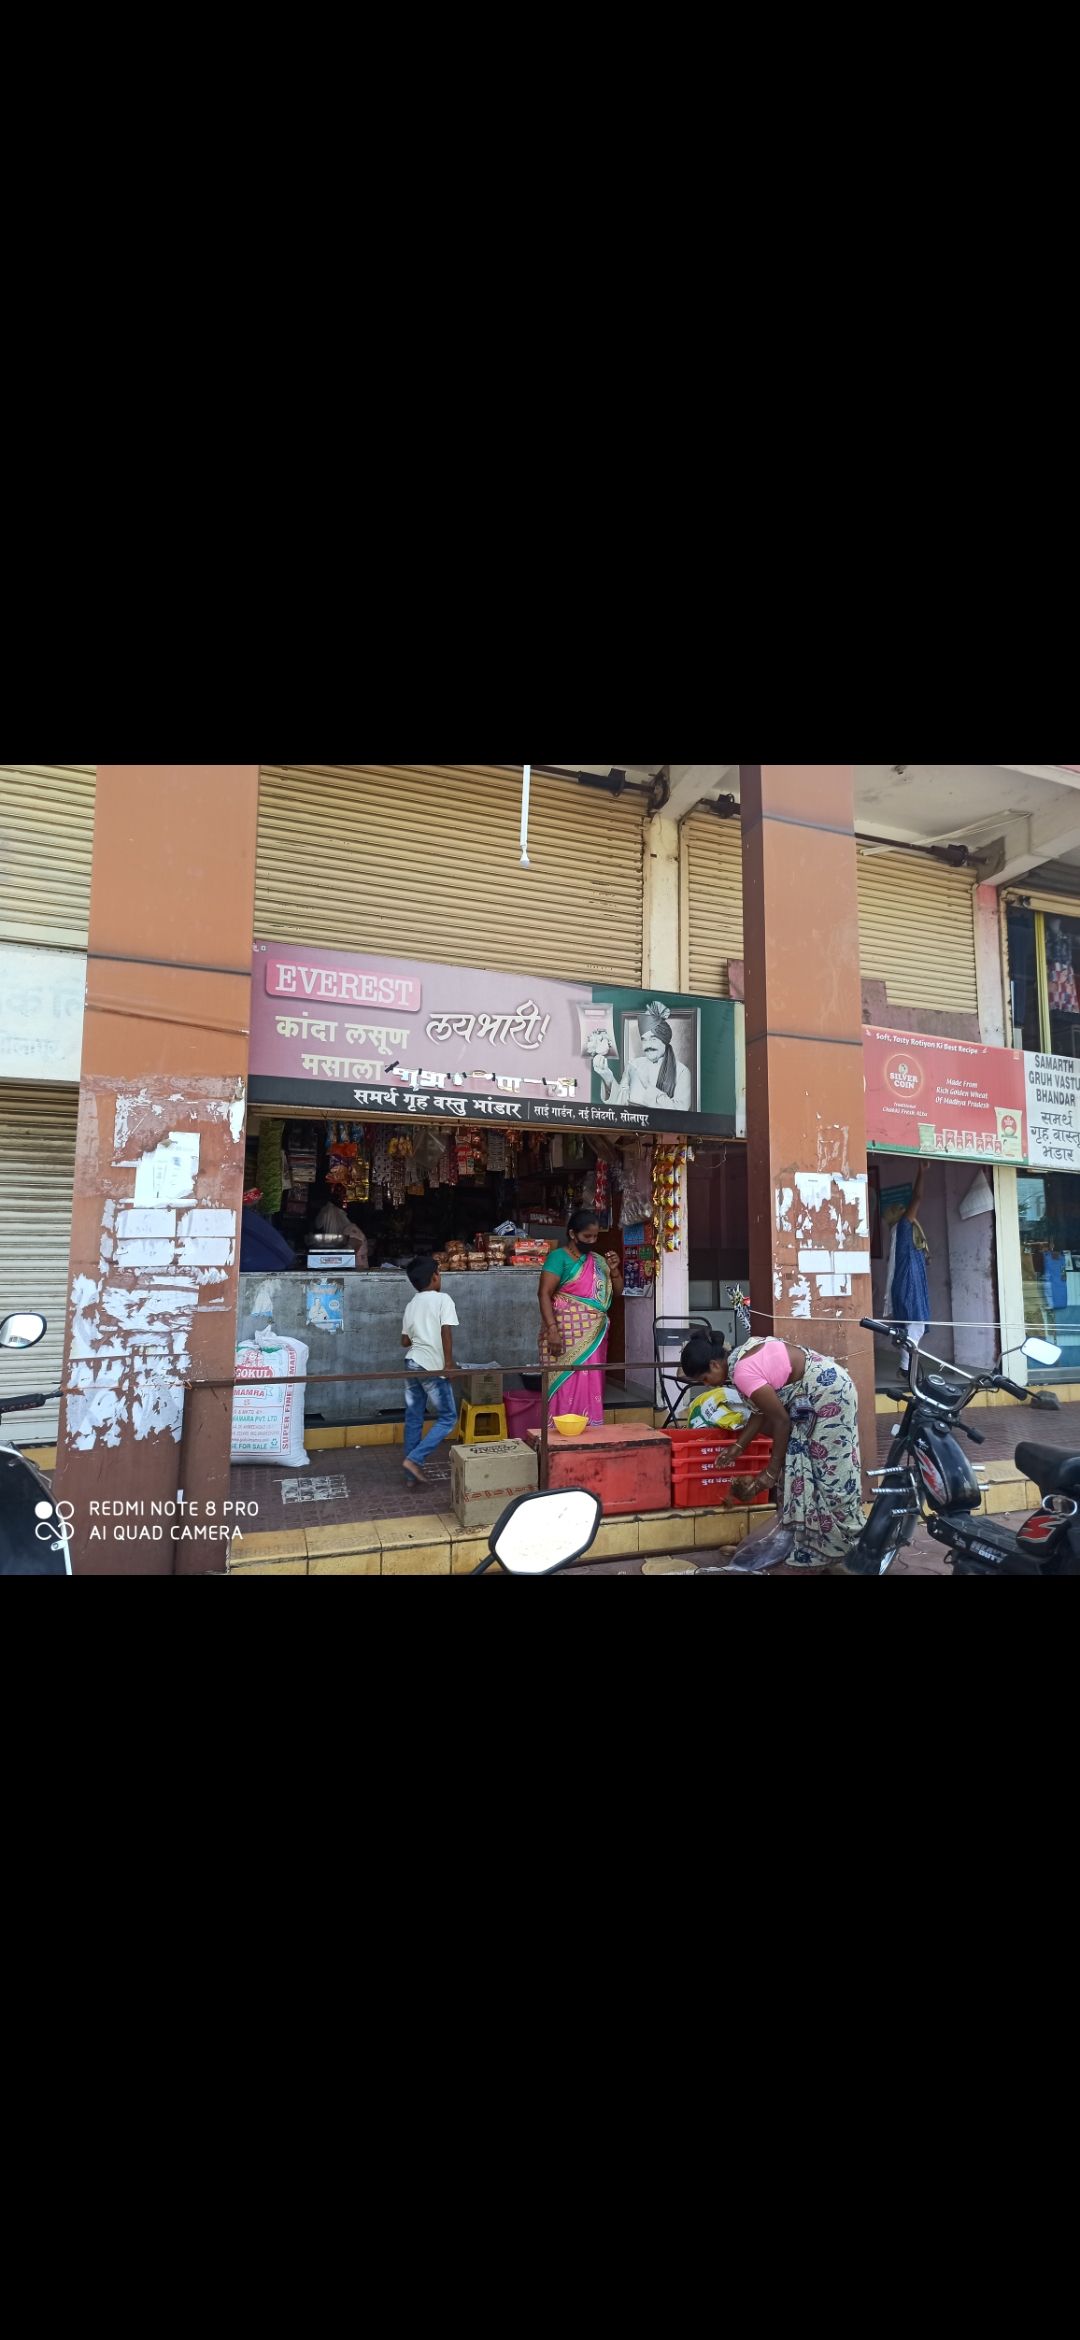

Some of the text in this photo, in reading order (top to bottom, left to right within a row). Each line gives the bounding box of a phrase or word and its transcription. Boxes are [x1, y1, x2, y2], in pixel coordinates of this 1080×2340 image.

[275, 964, 413, 1006] EVEREST
[275, 1011, 410, 1056] कांदा लसूण
[876, 1033, 892, 1043] Soft,
[944, 1044, 958, 1052] Best
[958, 1046, 978, 1055] Recipe
[301, 1053, 384, 1081] मसाला
[1035, 1055, 1074, 1074] SAMARTH
[890, 1072, 918, 1083] SILVER
[894, 1080, 915, 1089] COIN
[963, 1080, 978, 1089] From
[1028, 1071, 1080, 1090] GRUH VASTU
[353, 1088, 522, 1119] समर्थ गृह वस्तु भांडार
[1036, 1089, 1075, 1107] BHANDAR
[578, 1109, 590, 1122] नई
[620, 1111, 649, 1127] सोलापूर
[1040, 1111, 1073, 1127] समर्थ
[1029, 1125, 1050, 1144] गृह
[1042, 1142, 1075, 1162] भंडार
[282, 1416, 290, 1449] SUPER
